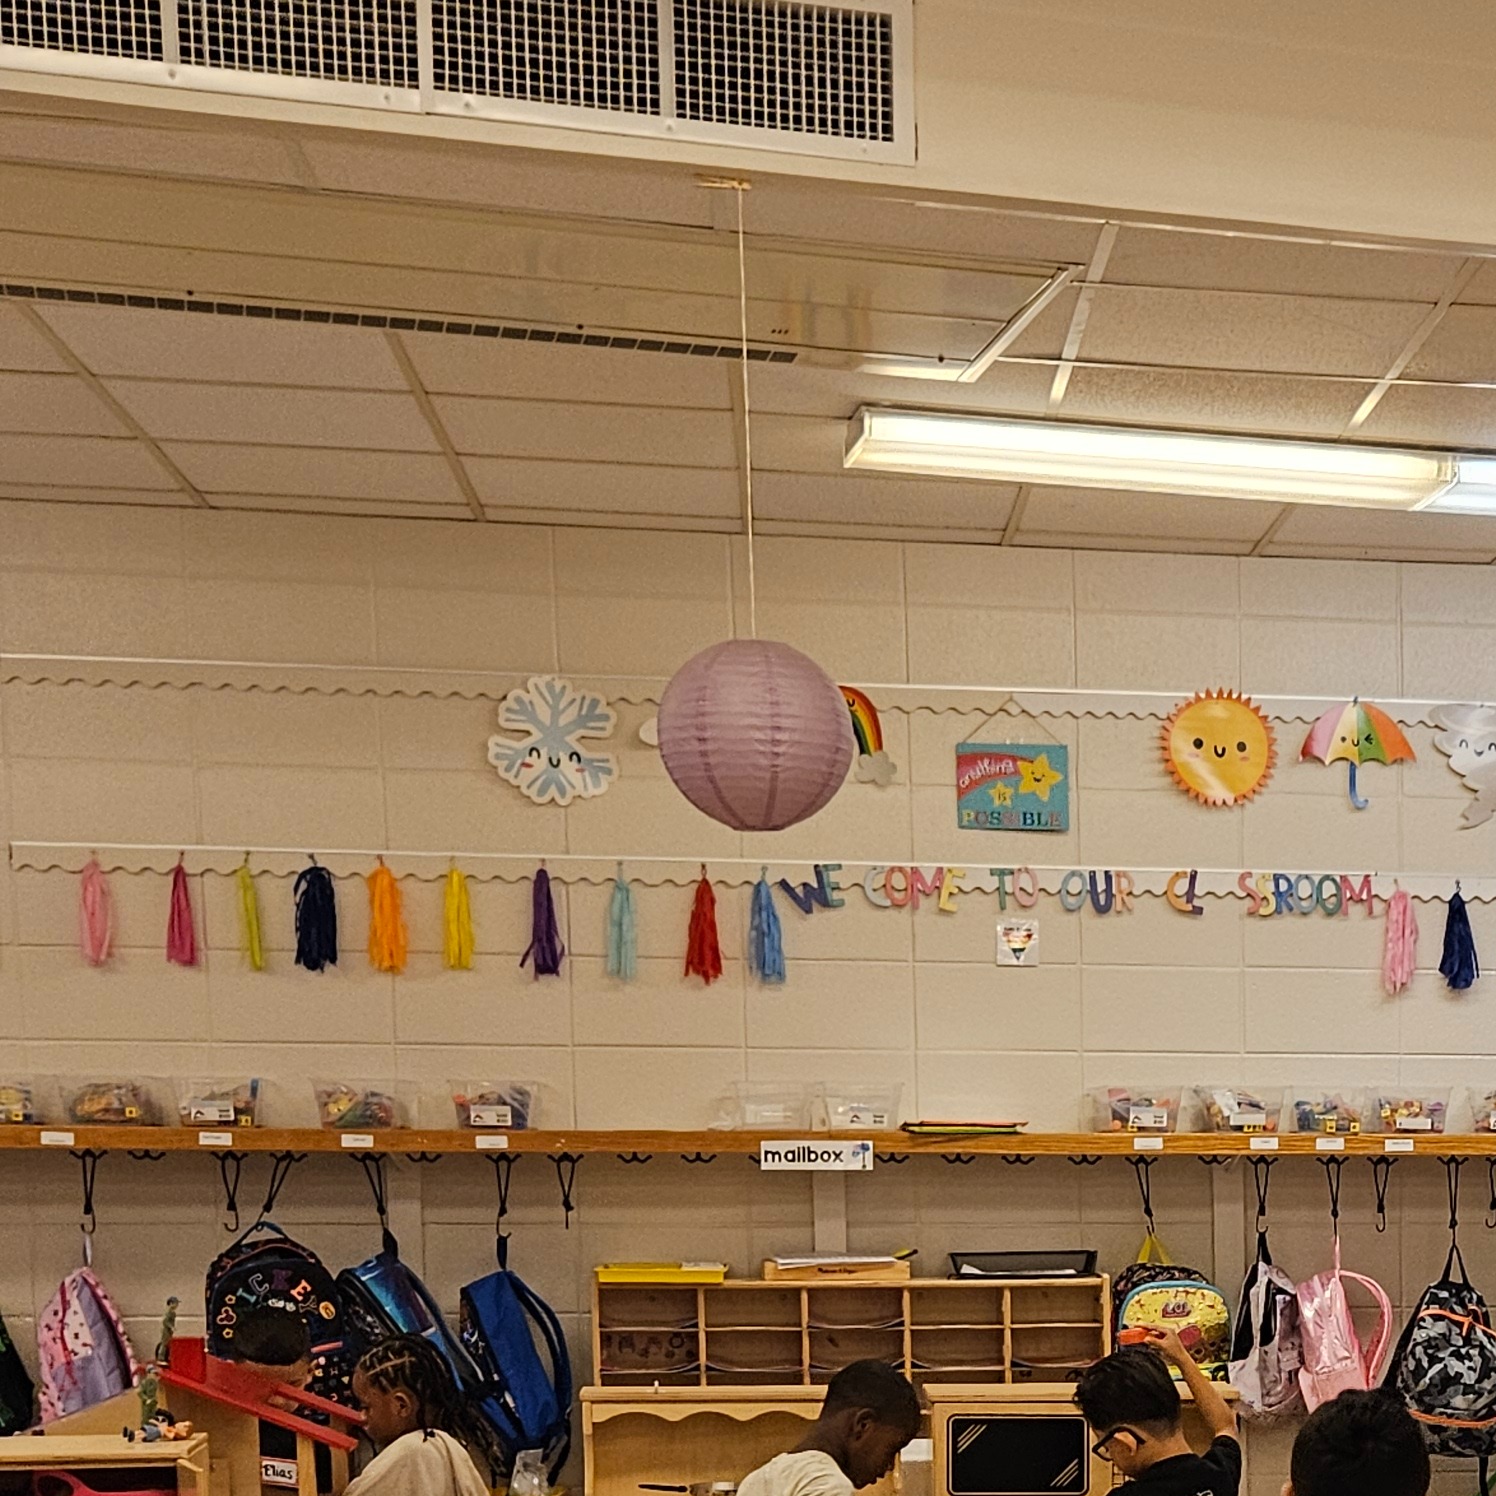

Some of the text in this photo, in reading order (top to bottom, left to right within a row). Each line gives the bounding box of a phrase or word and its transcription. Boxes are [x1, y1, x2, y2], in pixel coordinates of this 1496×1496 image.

[990, 867, 1039, 910] TO
[1060, 870, 1135, 914] OUR
[764, 1146, 844, 1163] mailbox
[263, 1464, 293, 1480] Elias
